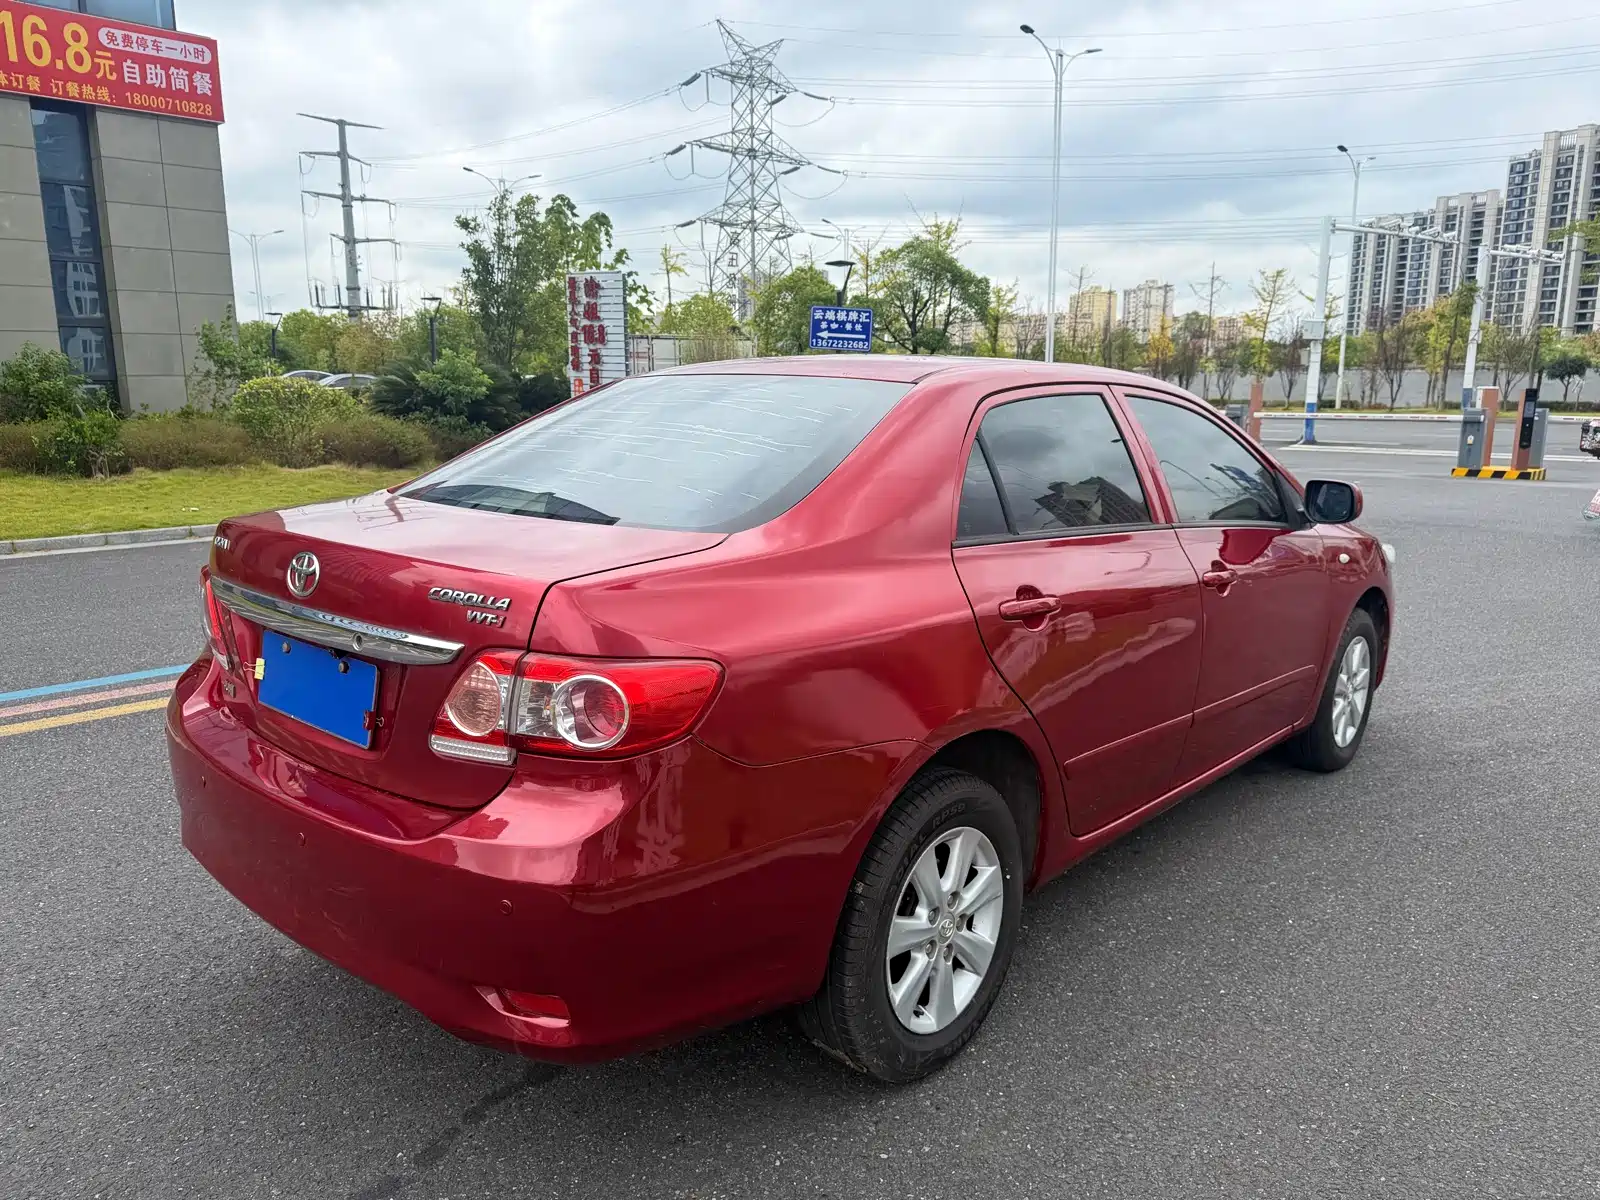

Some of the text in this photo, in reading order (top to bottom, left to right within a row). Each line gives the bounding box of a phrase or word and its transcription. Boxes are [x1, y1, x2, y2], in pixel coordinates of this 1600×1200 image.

[105, 30, 206, 62] 免费停车一小时
[122, 58, 213, 96] 自助简餐
[125, 91, 213, 116] 18000710828
[813, 309, 870, 323] 云端棋牌汇
[811, 338, 869, 349] 13672232682
[427, 587, 512, 611] COROLLA
